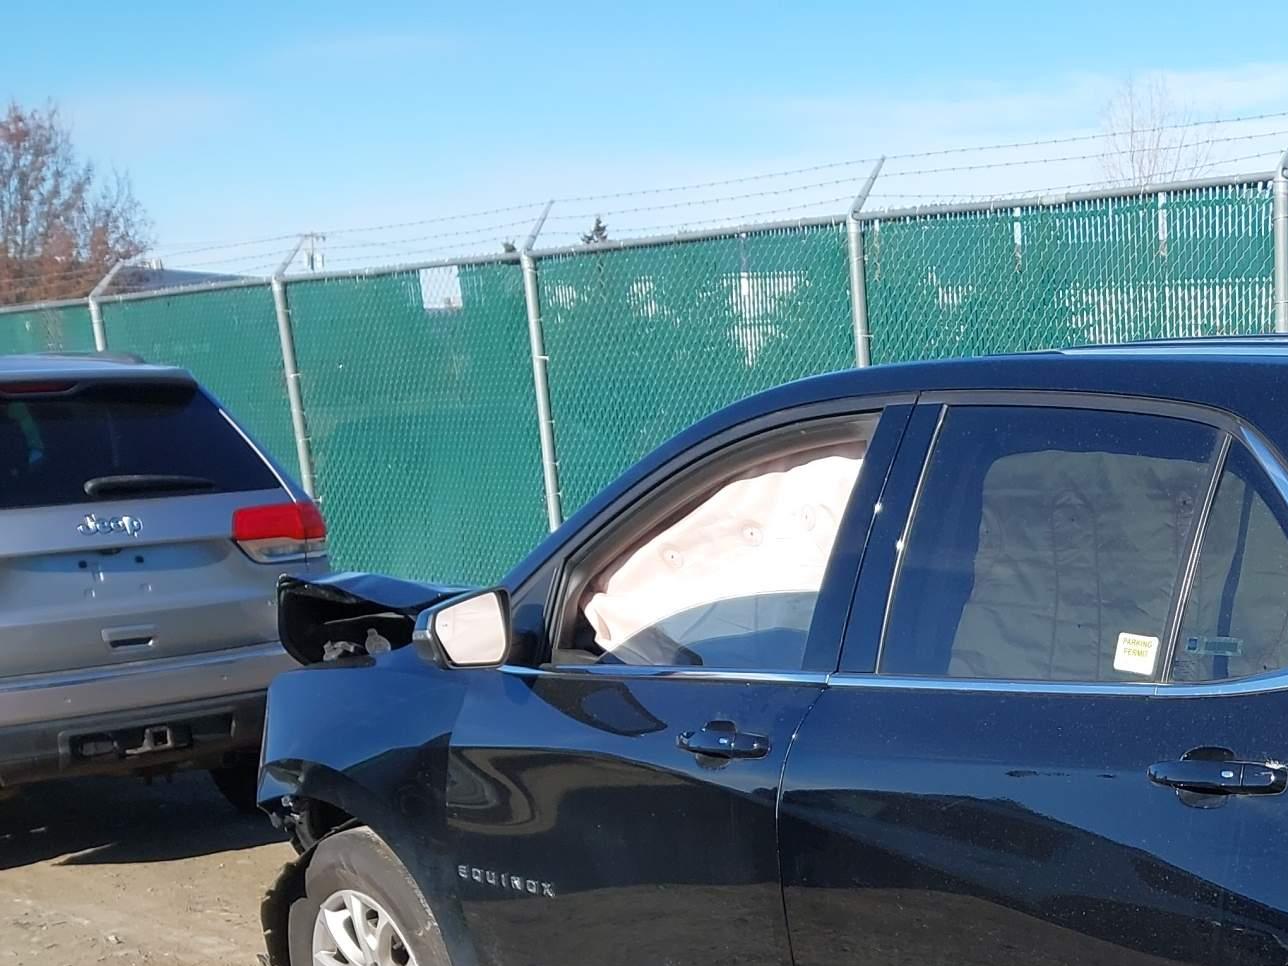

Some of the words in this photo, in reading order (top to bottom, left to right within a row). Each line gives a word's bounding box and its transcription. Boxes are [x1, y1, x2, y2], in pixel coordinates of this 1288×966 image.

[77, 513, 143, 538] Jeep
[1122, 636, 1153, 648] PARKING
[458, 864, 555, 897] EQUINOX
